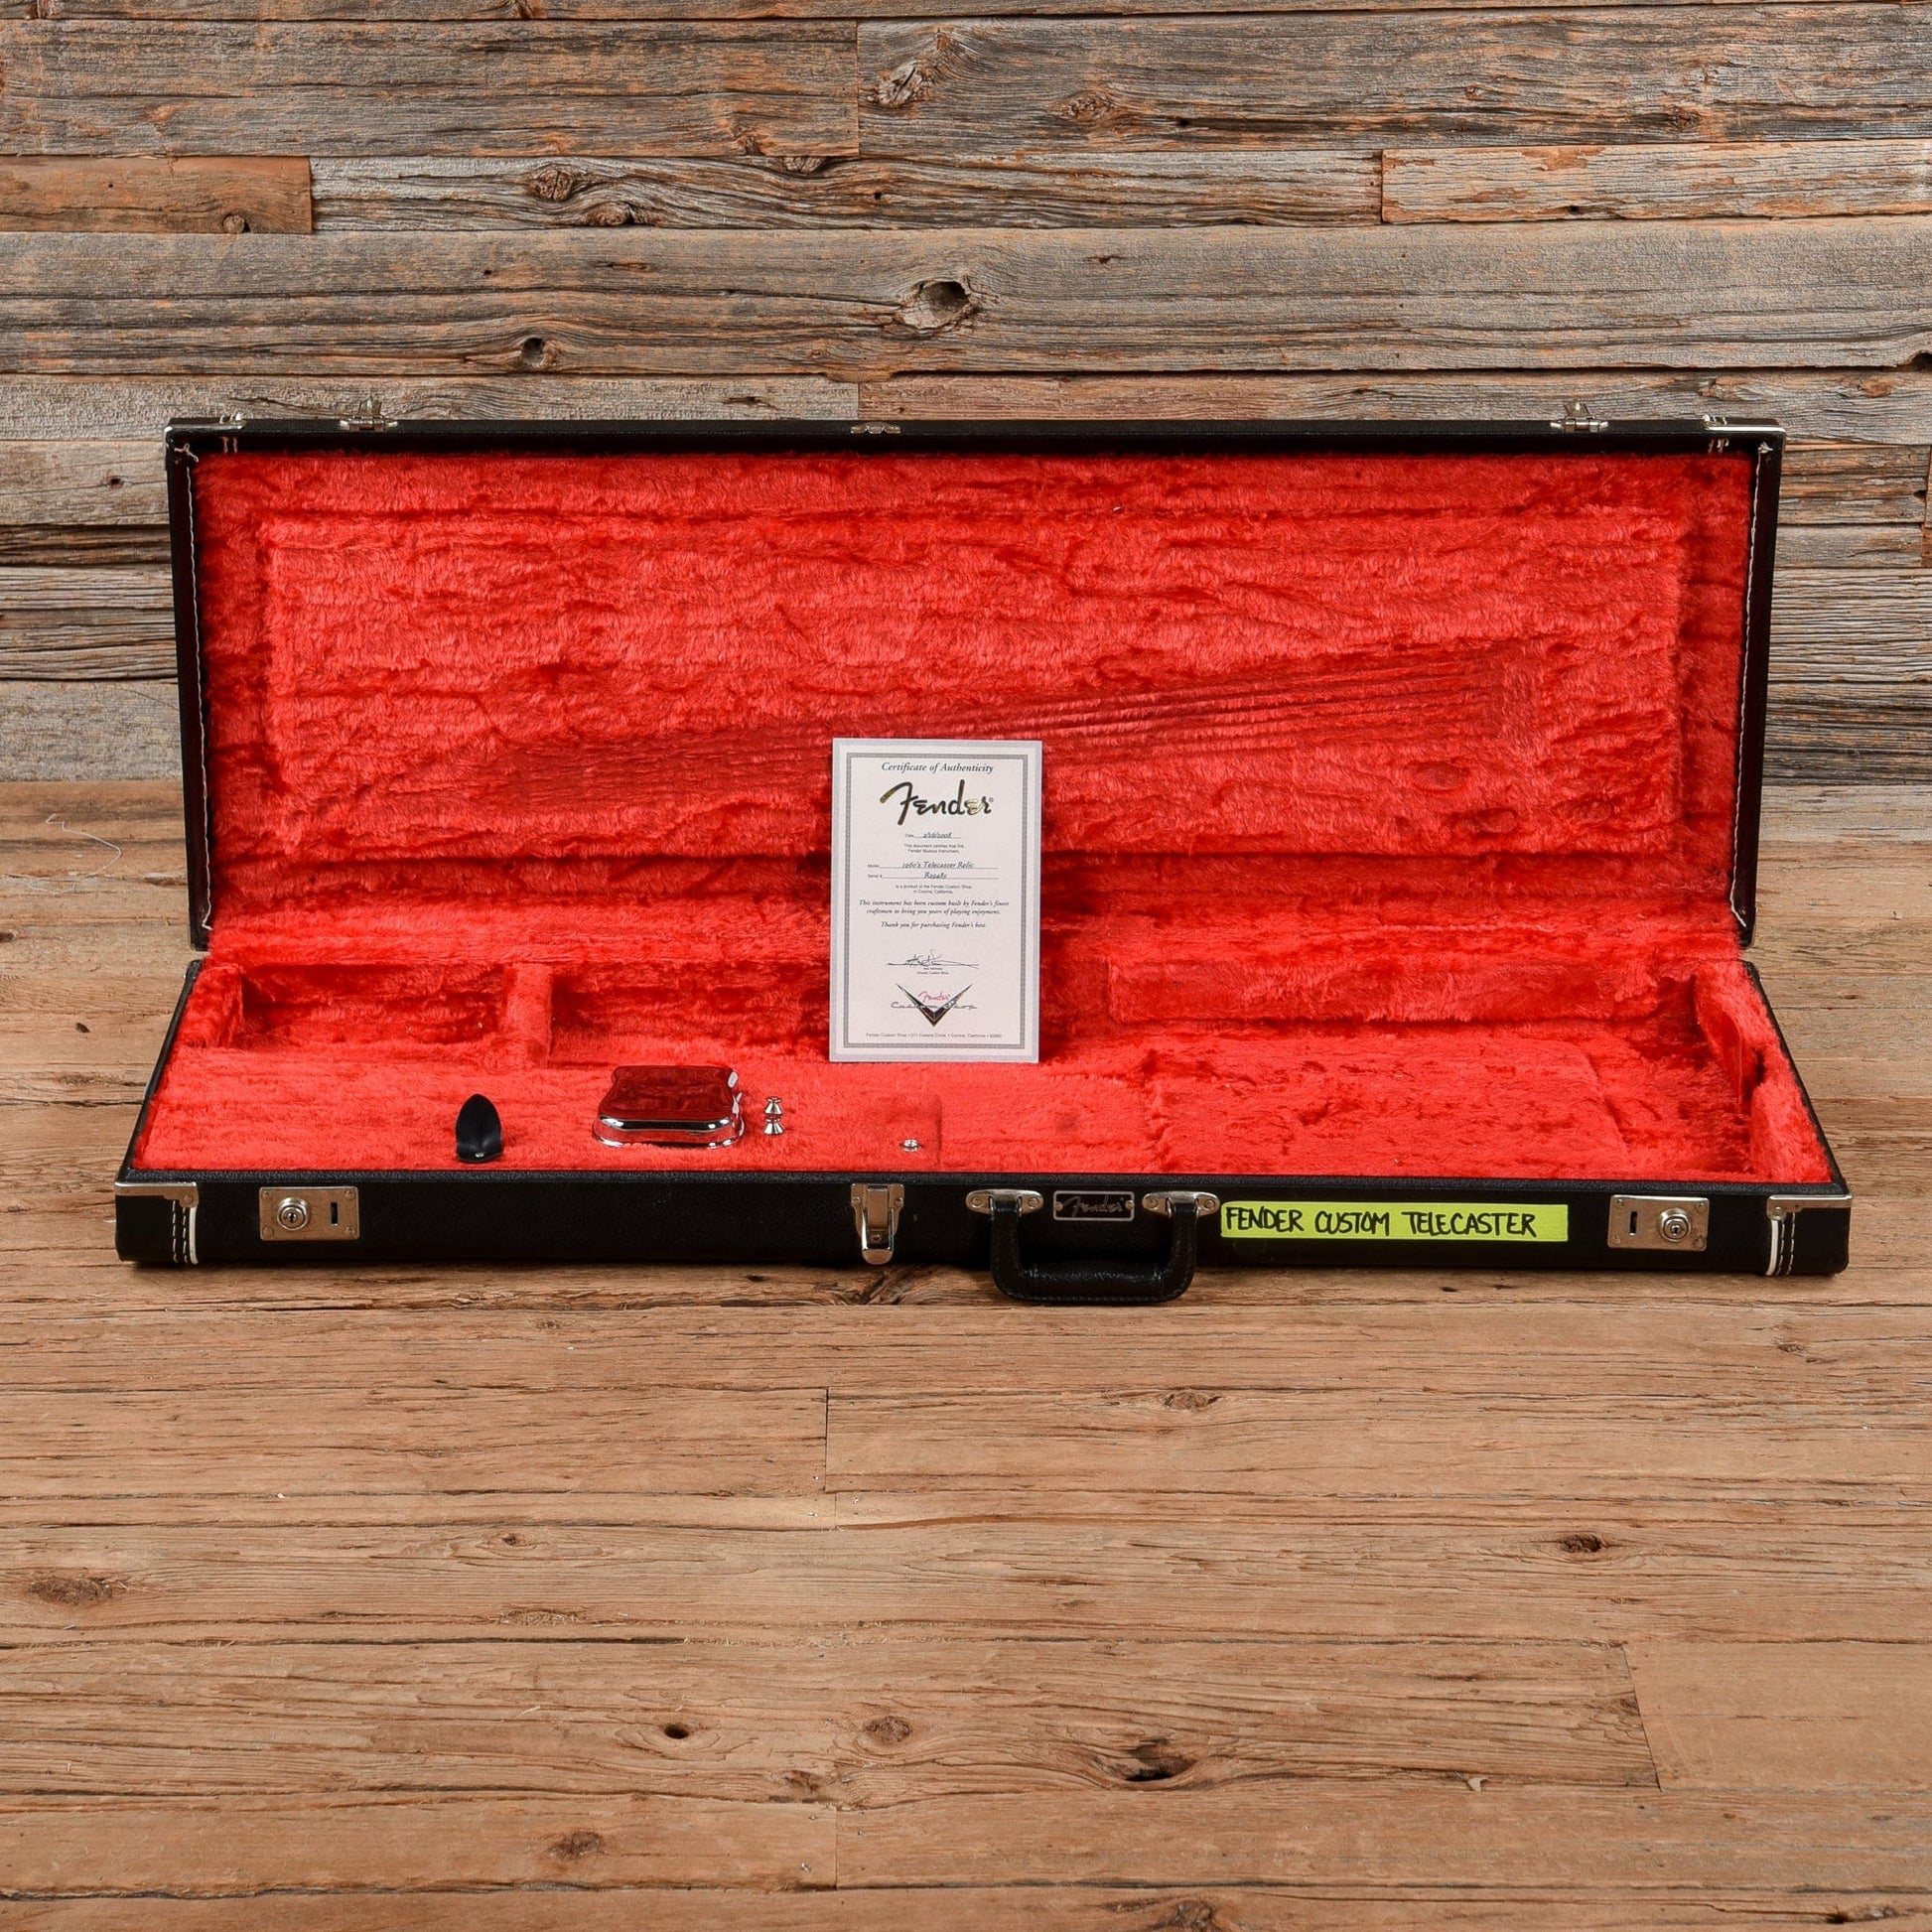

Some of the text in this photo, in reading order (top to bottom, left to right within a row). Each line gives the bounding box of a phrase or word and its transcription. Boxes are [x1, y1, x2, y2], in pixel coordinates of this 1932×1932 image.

[882, 761, 994, 774] Certificate of Authenticity
[880, 778, 992, 825] Fender
[923, 861, 956, 870] Telecaster
[957, 861, 975, 870] Relic
[949, 907, 970, 916] playing
[917, 991, 947, 1003] Fender
[1063, 1193, 1123, 1218] Fender
[1225, 1206, 1537, 1238] FENDER CUSTOM TELECASTER
